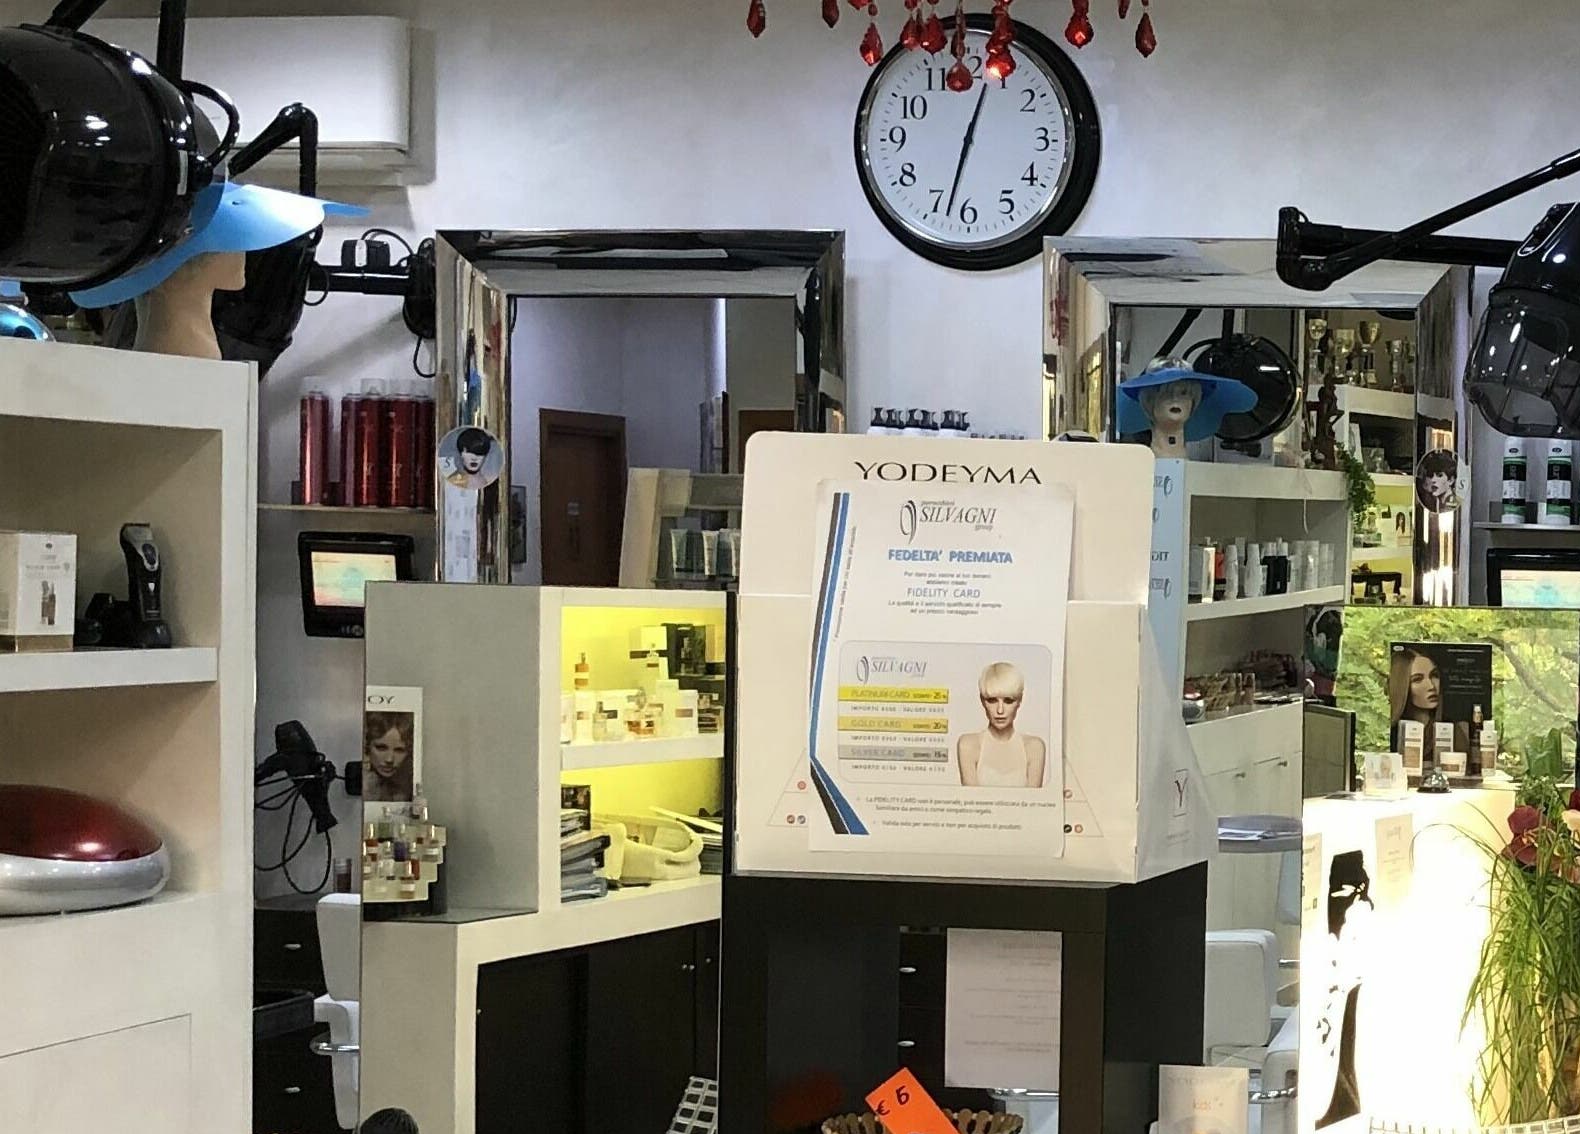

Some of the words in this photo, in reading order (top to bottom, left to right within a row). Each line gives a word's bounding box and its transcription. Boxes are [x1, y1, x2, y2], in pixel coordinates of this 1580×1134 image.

[900, 95, 928, 121] 10
[1019, 88, 1036, 113] 2
[888, 126, 907, 153] 9
[1034, 127, 1050, 152] 3
[899, 162, 917, 187] 8
[1020, 161, 1039, 187] 4
[928, 189, 944, 213] 7
[959, 198, 978, 225] 6
[999, 189, 1015, 215] 5
[854, 461, 1042, 485] YODEYMA
[919, 506, 997, 525] SILVAGNI
[949, 550, 1013, 563] PREMIATA
[907, 588, 948, 598] FIDELITY
[953, 589, 981, 599] CARD
[870, 660, 928, 673] SILVAGNI
